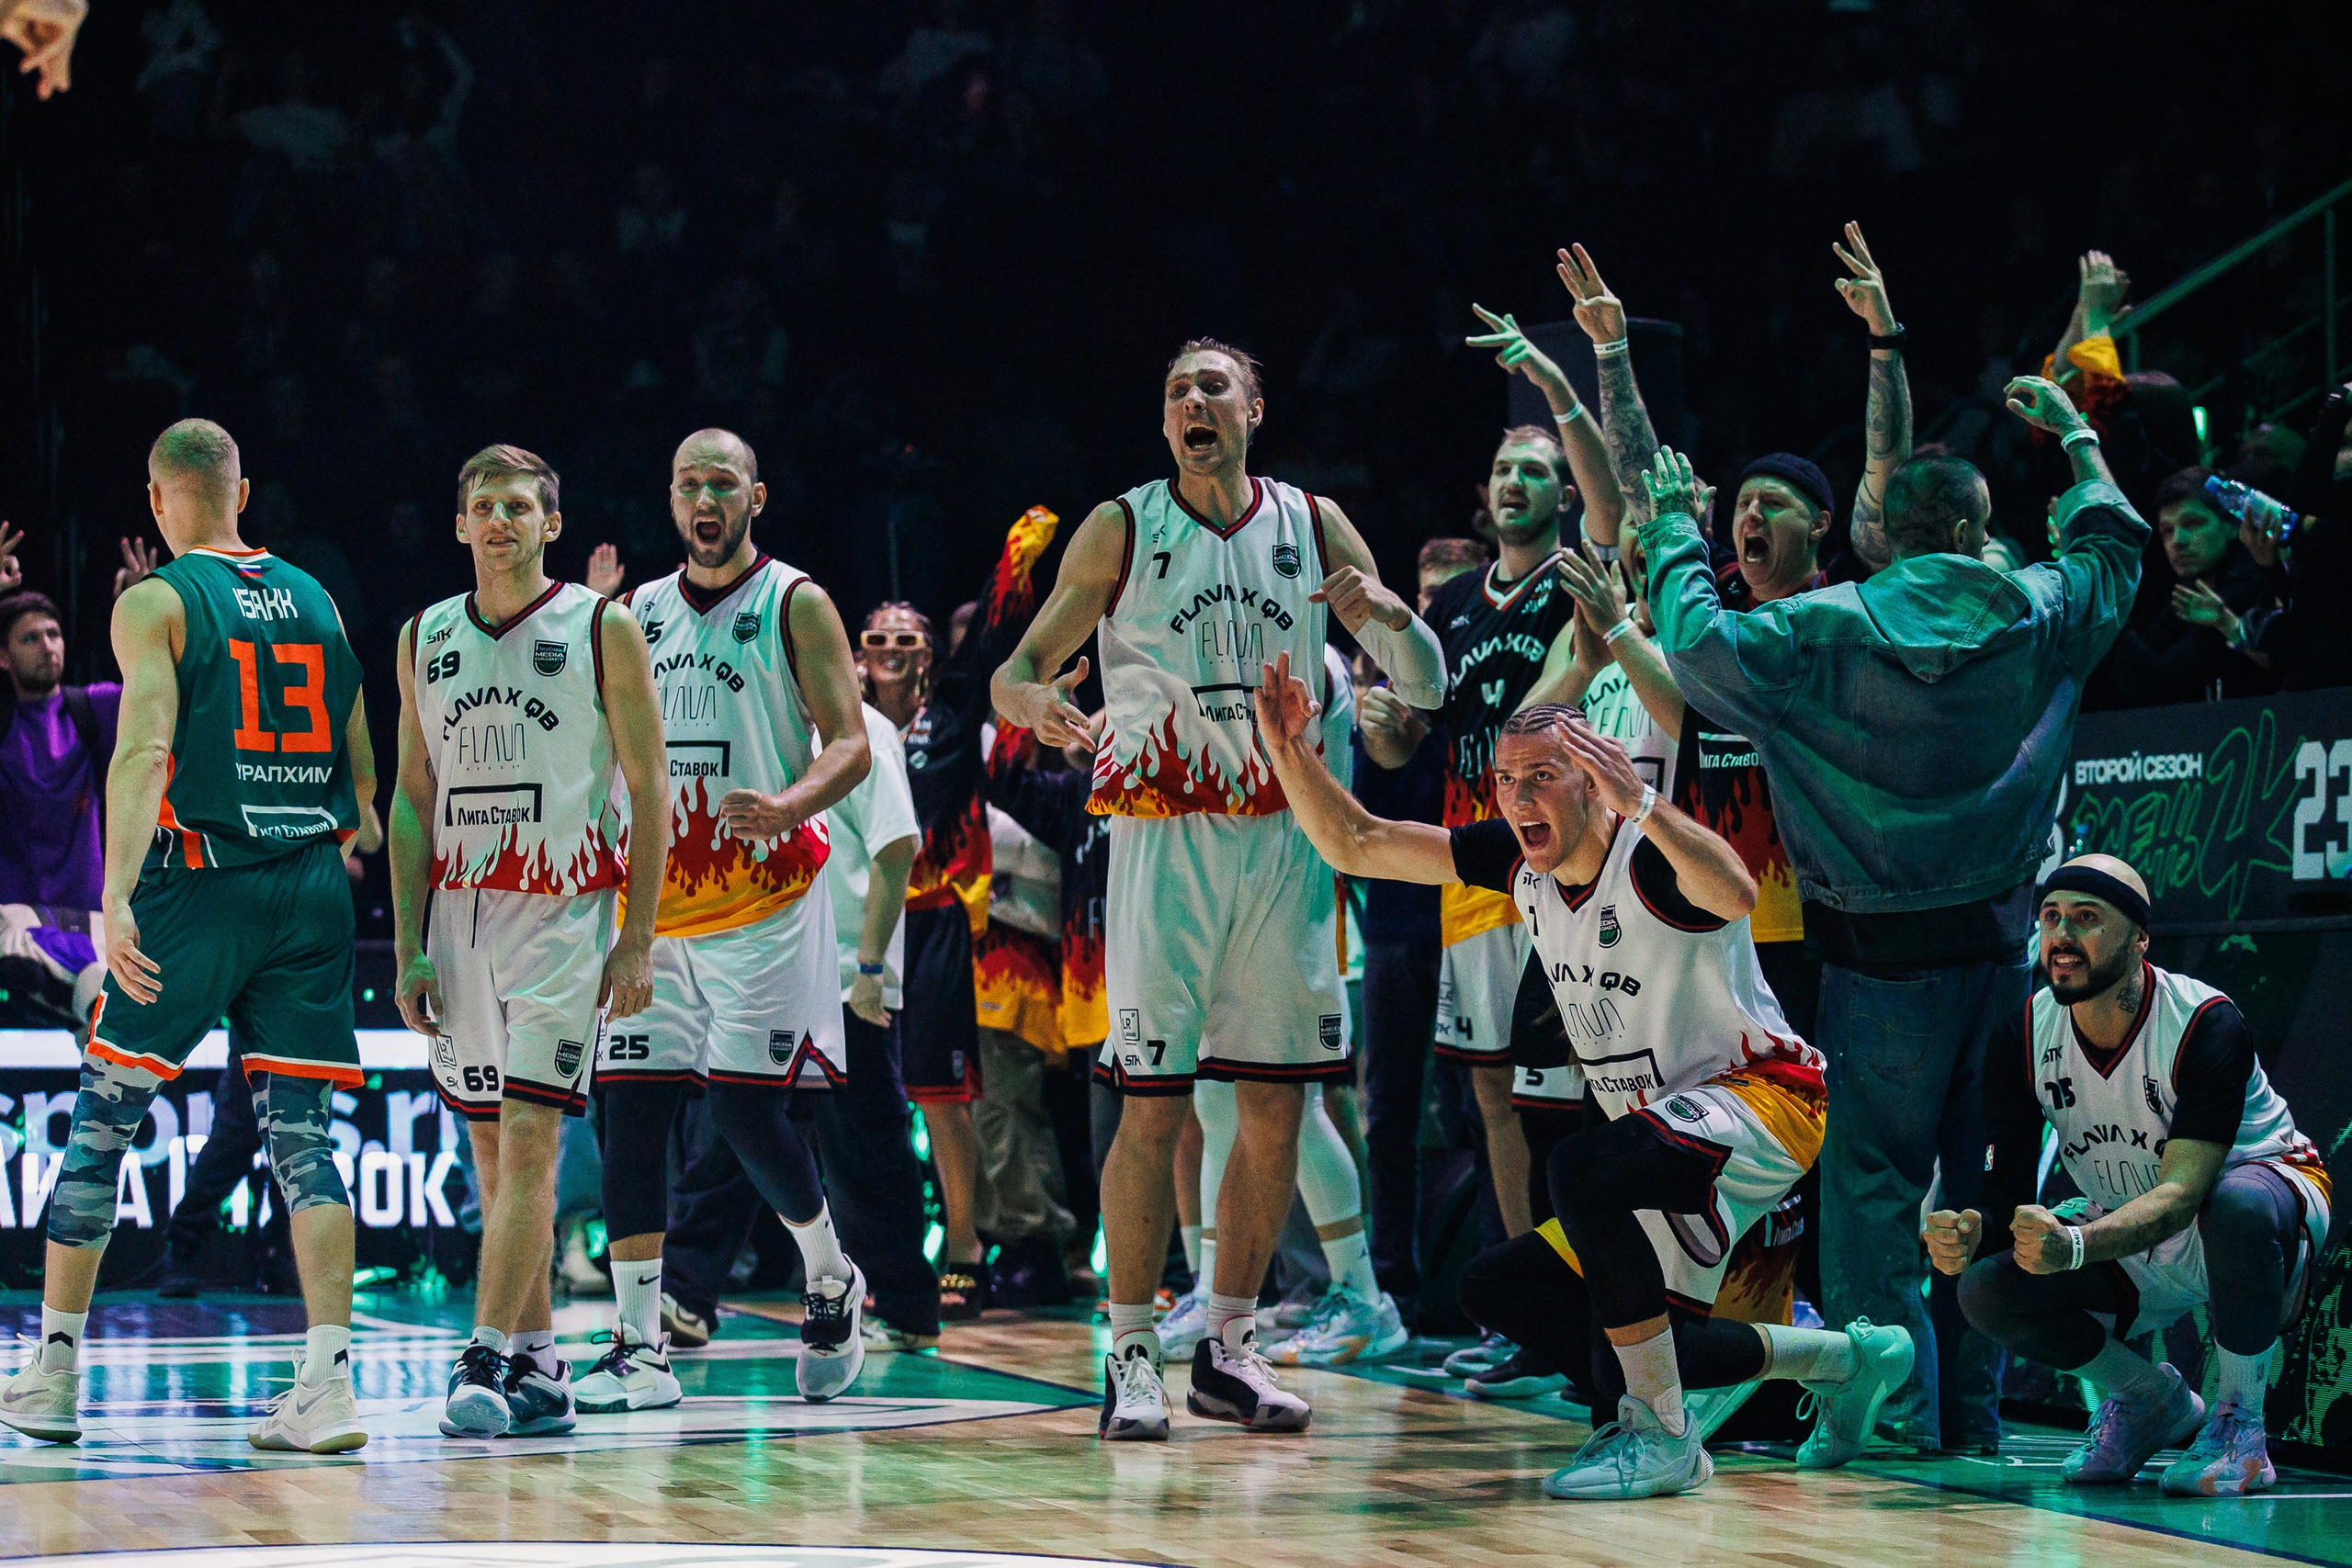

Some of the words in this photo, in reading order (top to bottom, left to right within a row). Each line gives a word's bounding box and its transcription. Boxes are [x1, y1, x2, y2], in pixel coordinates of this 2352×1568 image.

[1152, 551, 1171, 580] 7
[1170, 583, 1236, 635] FLAVA
[1261, 598, 1294, 631] QB
[426, 628, 453, 644] STK
[640, 620, 664, 644] 5
[427, 650, 460, 684] 69
[654, 653, 695, 680] AVA
[716, 661, 745, 693] QB
[229, 638, 332, 752] 13
[658, 685, 716, 720] LAVA
[1481, 678, 1505, 708] 4
[525, 697, 560, 731] QB
[1205, 705, 1236, 722] ЛИГА
[670, 759, 718, 777] СТАВОК
[1721, 752, 1759, 768] СТАВО
[2075, 750, 2142, 785] ВТОРОЙ
[2143, 752, 2202, 781] СЕЗОН
[235, 763, 332, 784] УРАЛХИМ
[458, 807, 490, 826] ЛИГА
[491, 806, 530, 825] СТАВОК
[2292, 739, 2352, 880] 23
[1600, 972, 1641, 997] QB
[1455, 1016, 1474, 1040] 4
[609, 1034, 650, 1060] 25
[1147, 1040, 1166, 1066] 7
[2043, 1045, 2063, 1064] STK
[462, 1066, 499, 1091] 69
[1601, 1074, 1655, 1092] СТАВОК
[2064, 1124, 2127, 1164] FLAVA
